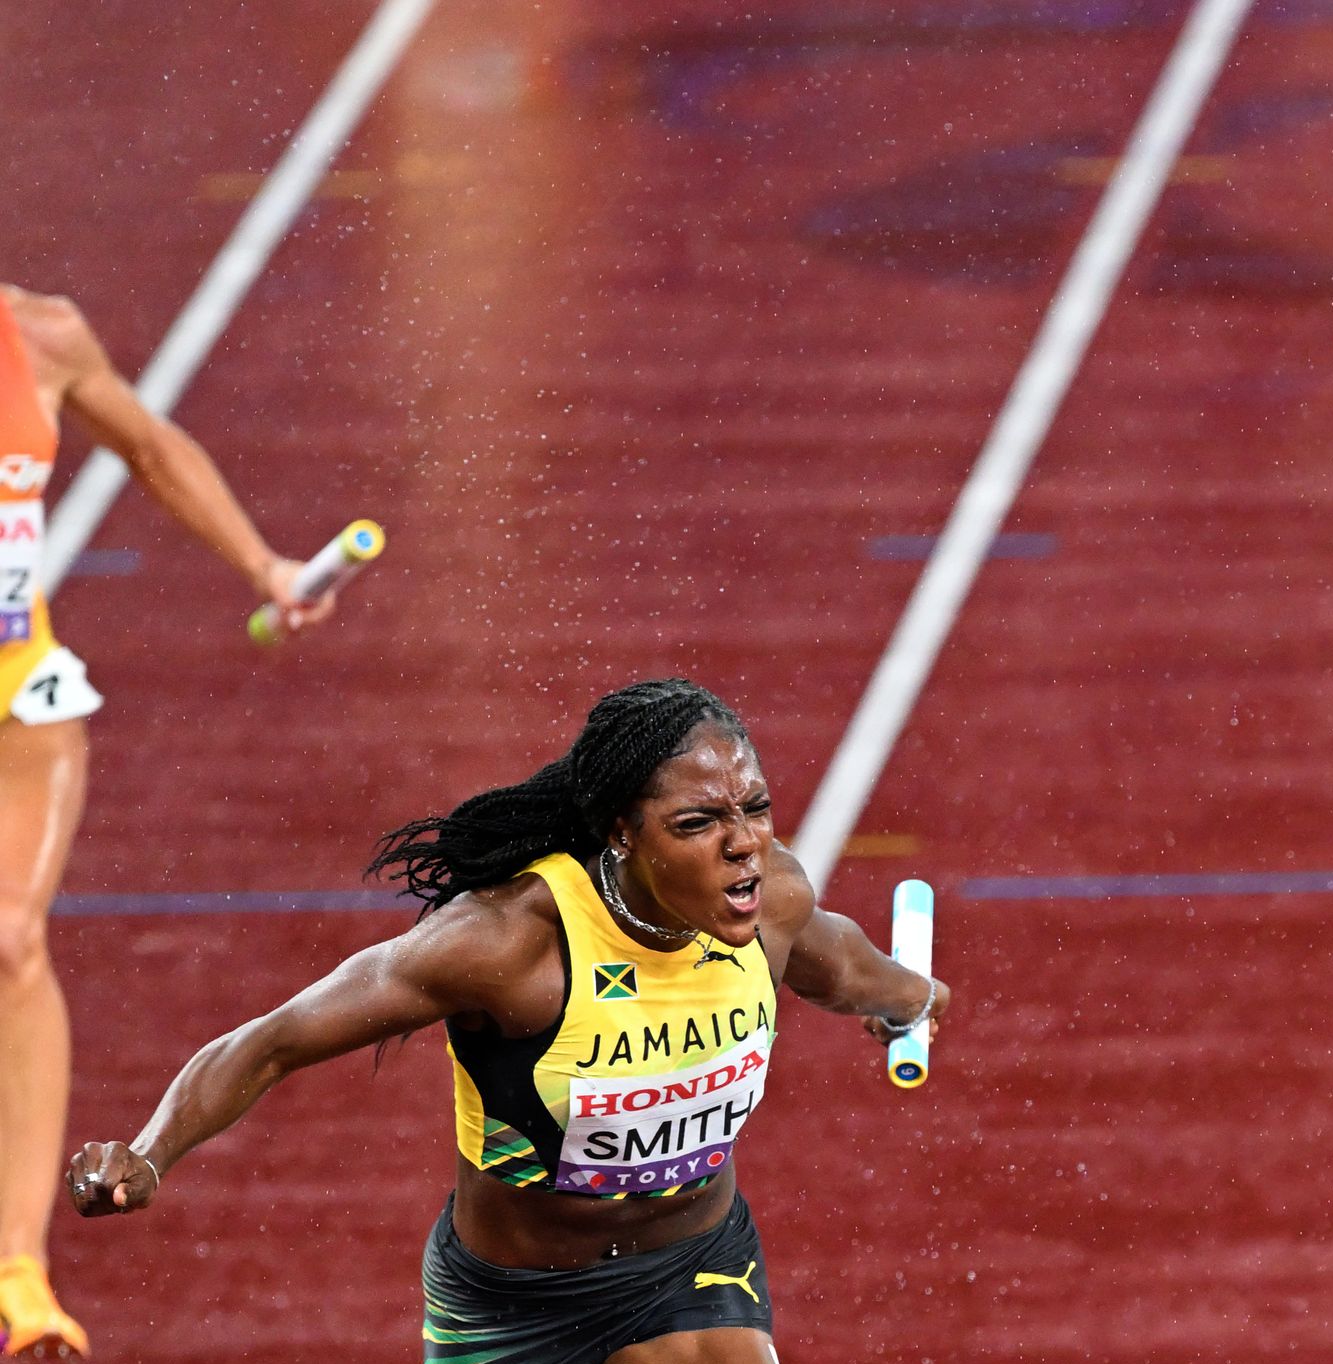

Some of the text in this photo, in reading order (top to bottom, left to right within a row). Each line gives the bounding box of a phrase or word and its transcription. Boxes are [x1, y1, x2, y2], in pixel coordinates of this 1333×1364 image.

[576, 1001, 770, 1068] JAMAICA
[576, 1050, 767, 1119] HONDA
[583, 1091, 754, 1161] SMITH
